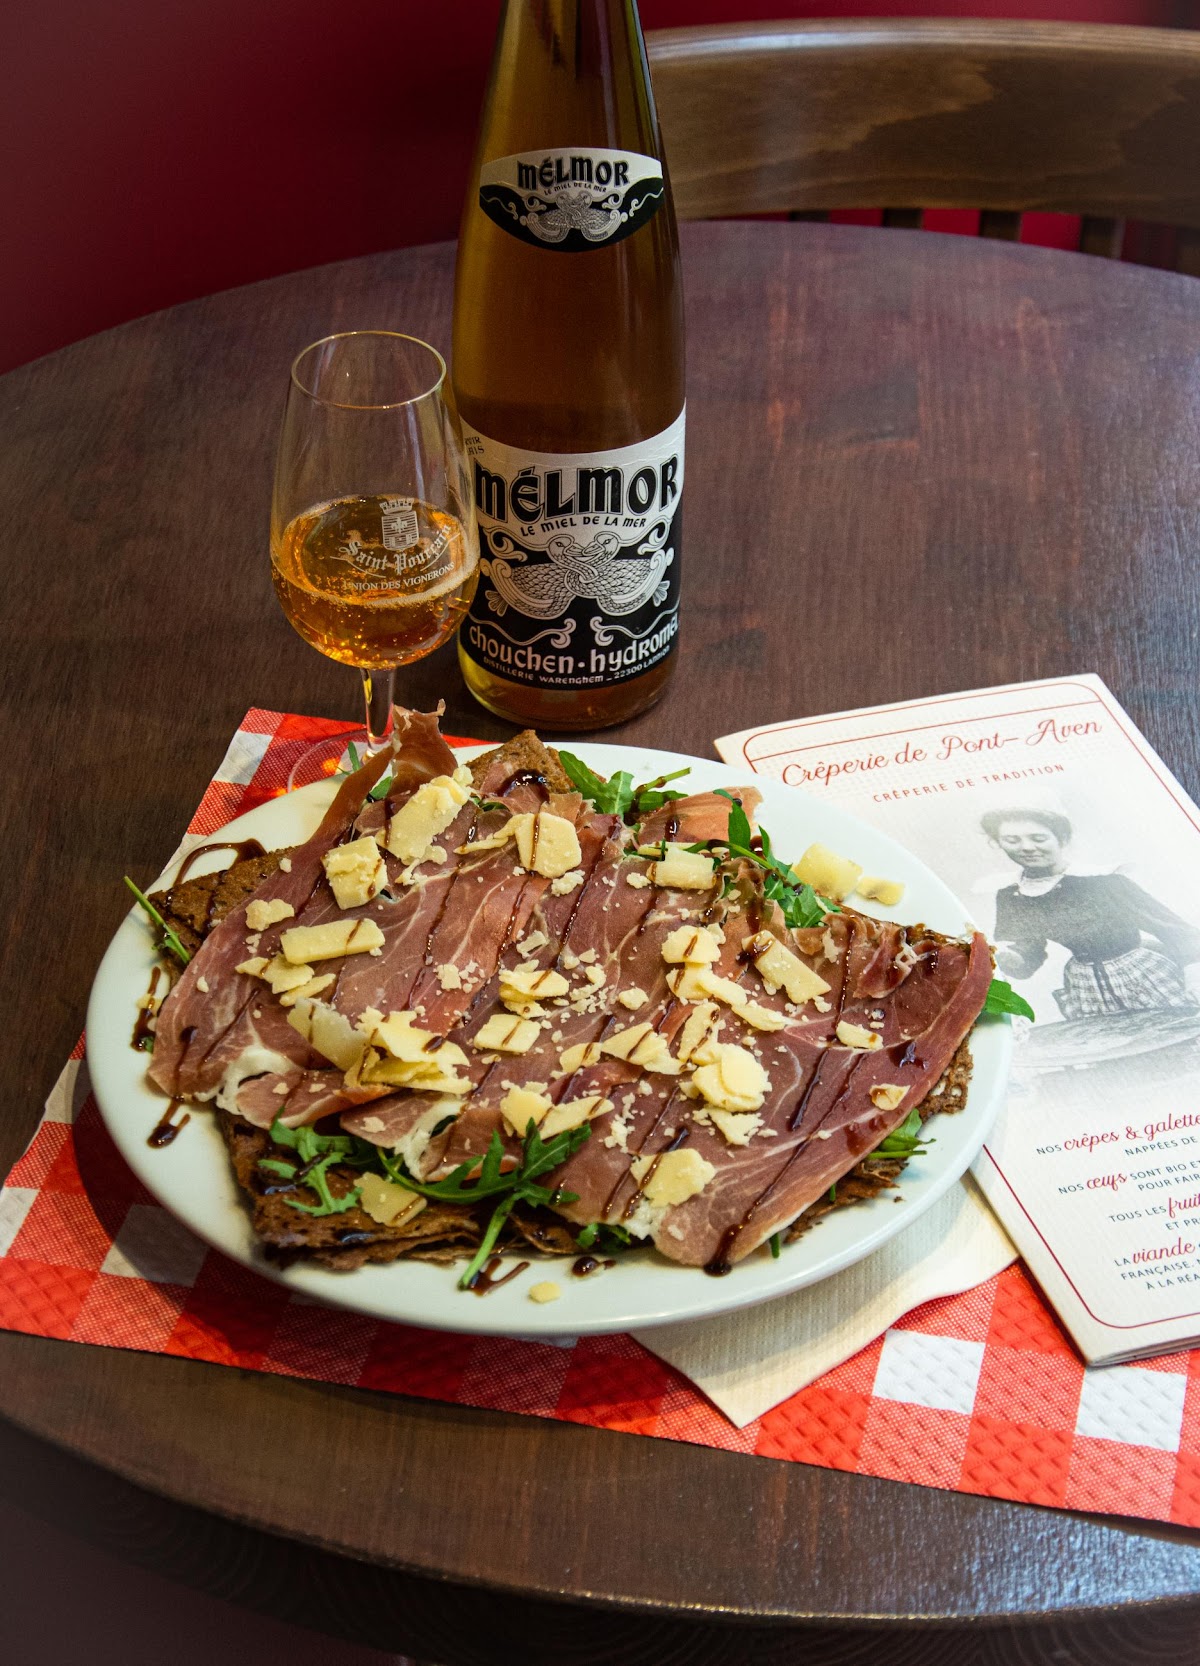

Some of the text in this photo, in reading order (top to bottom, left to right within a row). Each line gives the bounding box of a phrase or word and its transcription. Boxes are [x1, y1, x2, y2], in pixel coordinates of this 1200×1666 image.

[474, 453, 678, 523] MÉLMOR
[520, 515, 647, 537] LE MIEL DE LA MER
[380, 580, 401, 590] DES
[404, 561, 455, 588] VIGNERONS
[782, 753, 890, 786] Crêperie
[895, 741, 928, 764] de
[872, 763, 1066, 803] CRÊPERIE DE TRADITION
[1036, 1143, 1063, 1156] NOS
[1063, 1131, 1120, 1153] crêpes
[1125, 1125, 1144, 1140] &
[1124, 1135, 1199, 1156] NAPPÉES DE
[1058, 1183, 1085, 1195] NOS
[1129, 1167, 1162, 1181] SONT
[1165, 1162, 1188, 1174] BIO
[1137, 1179, 1173, 1192] POUR
[1108, 1210, 1143, 1223] TOUS
[1144, 1205, 1168, 1216] LES
[1165, 1220, 1180, 1231] ET
[1113, 1257, 1132, 1268] LA
[1132, 1236, 1196, 1264] viande
[1157, 1278, 1175, 1288] LA
